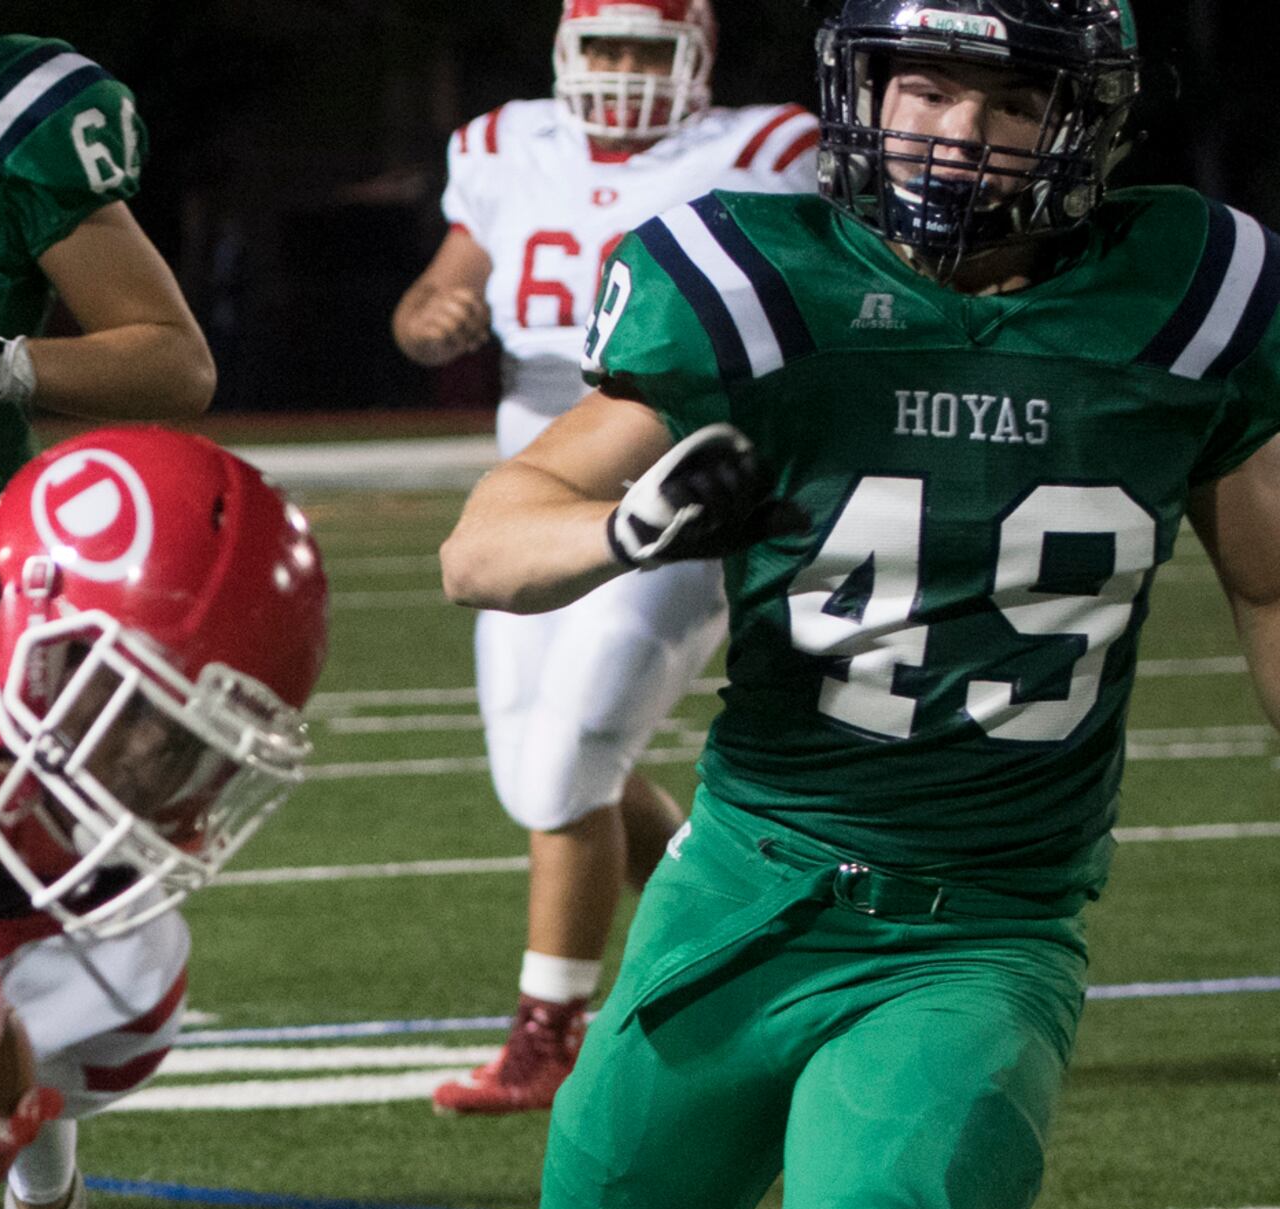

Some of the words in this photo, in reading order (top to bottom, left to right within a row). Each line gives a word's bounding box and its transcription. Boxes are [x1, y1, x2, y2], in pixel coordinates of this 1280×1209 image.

[935, 17, 981, 35] HOAS
[893, 389, 1051, 445] HOYAS
[787, 475, 1157, 742] 49
